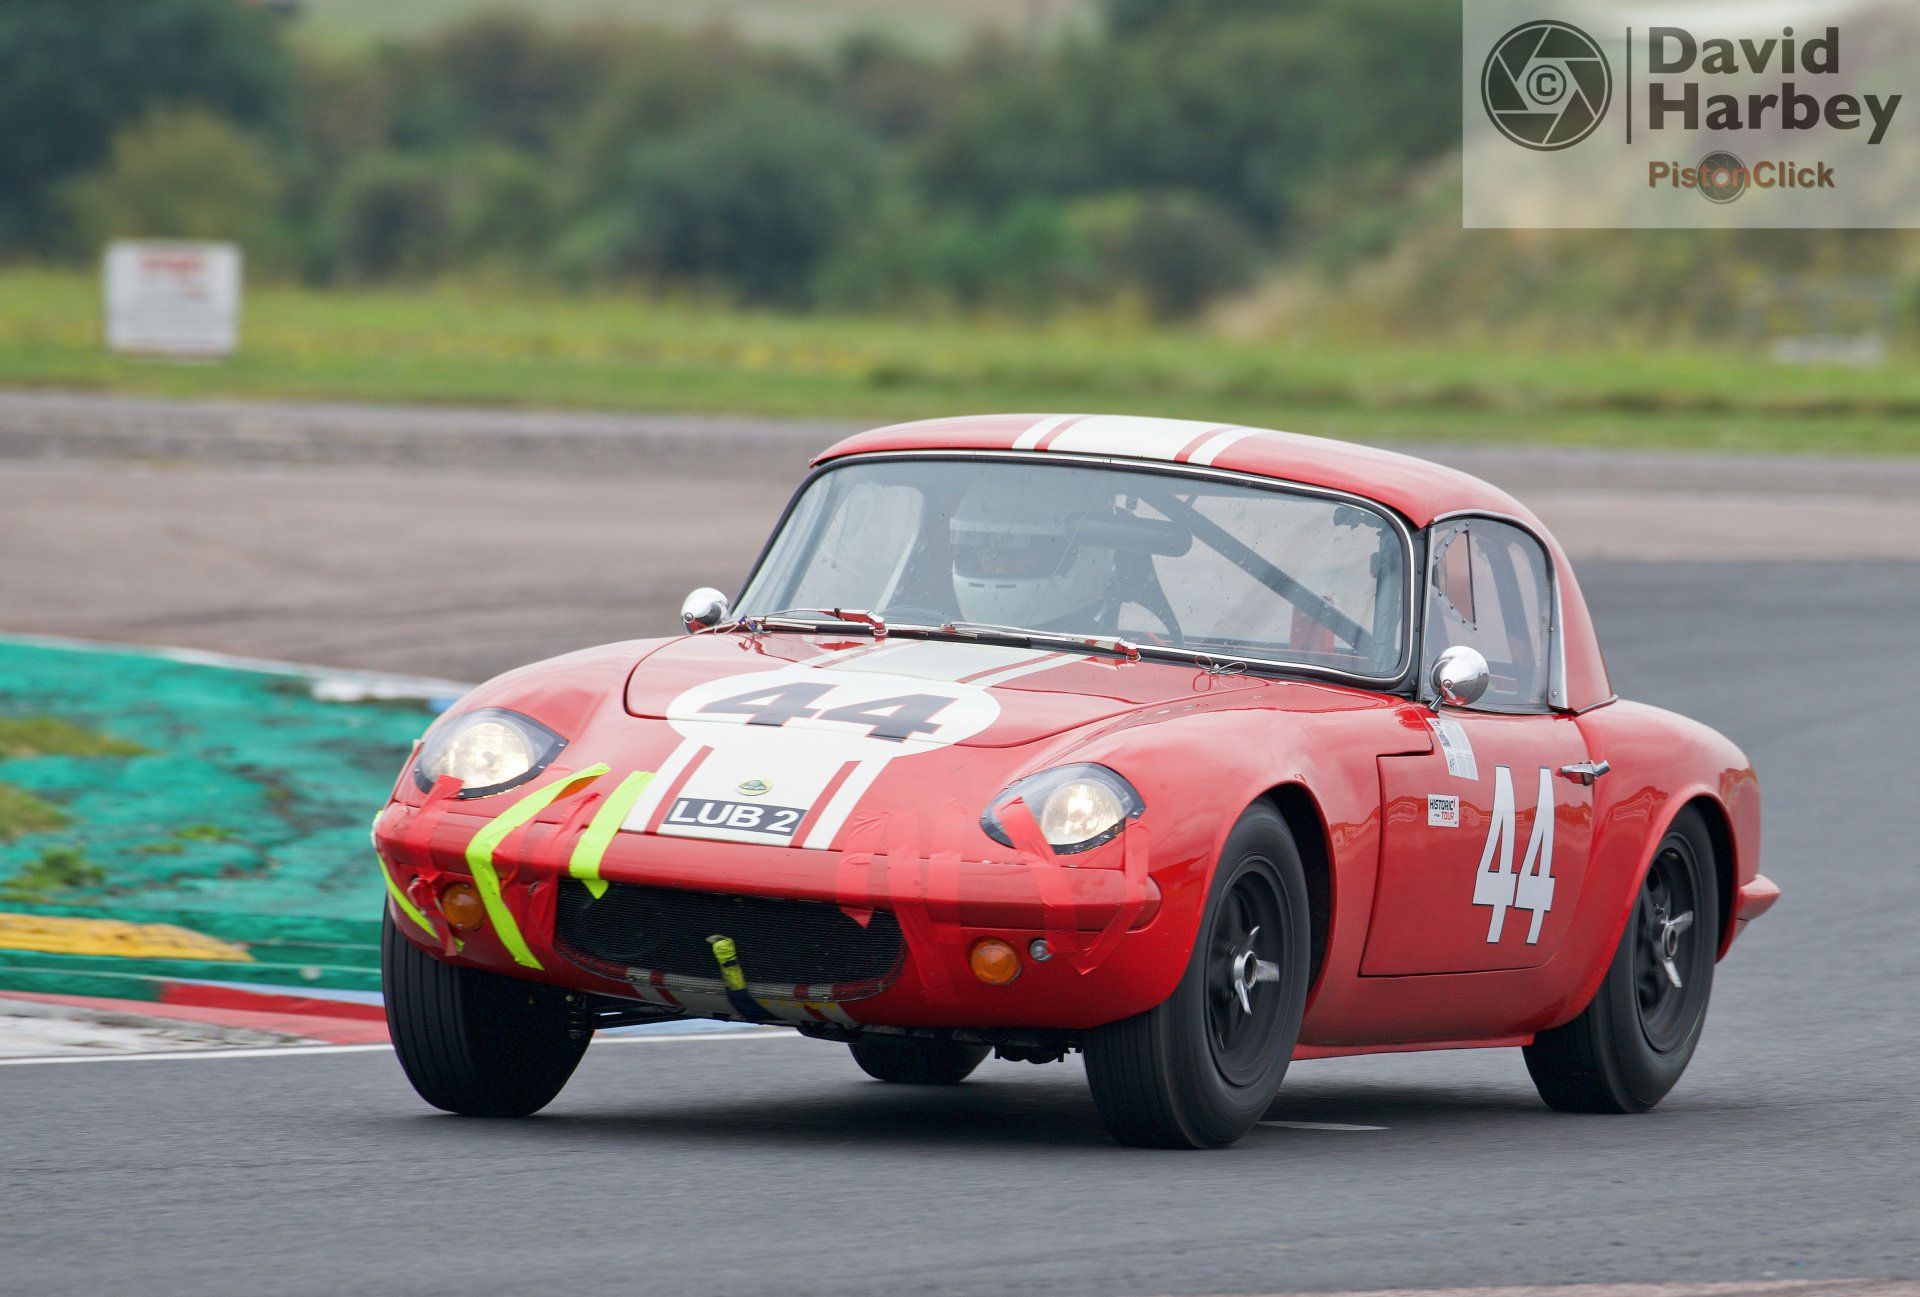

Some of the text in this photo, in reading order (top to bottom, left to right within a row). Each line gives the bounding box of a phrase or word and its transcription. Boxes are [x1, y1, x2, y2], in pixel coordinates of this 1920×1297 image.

[697, 681, 959, 743] 44
[670, 801, 800, 833] LUB 2
[1472, 765, 1556, 944] 44
